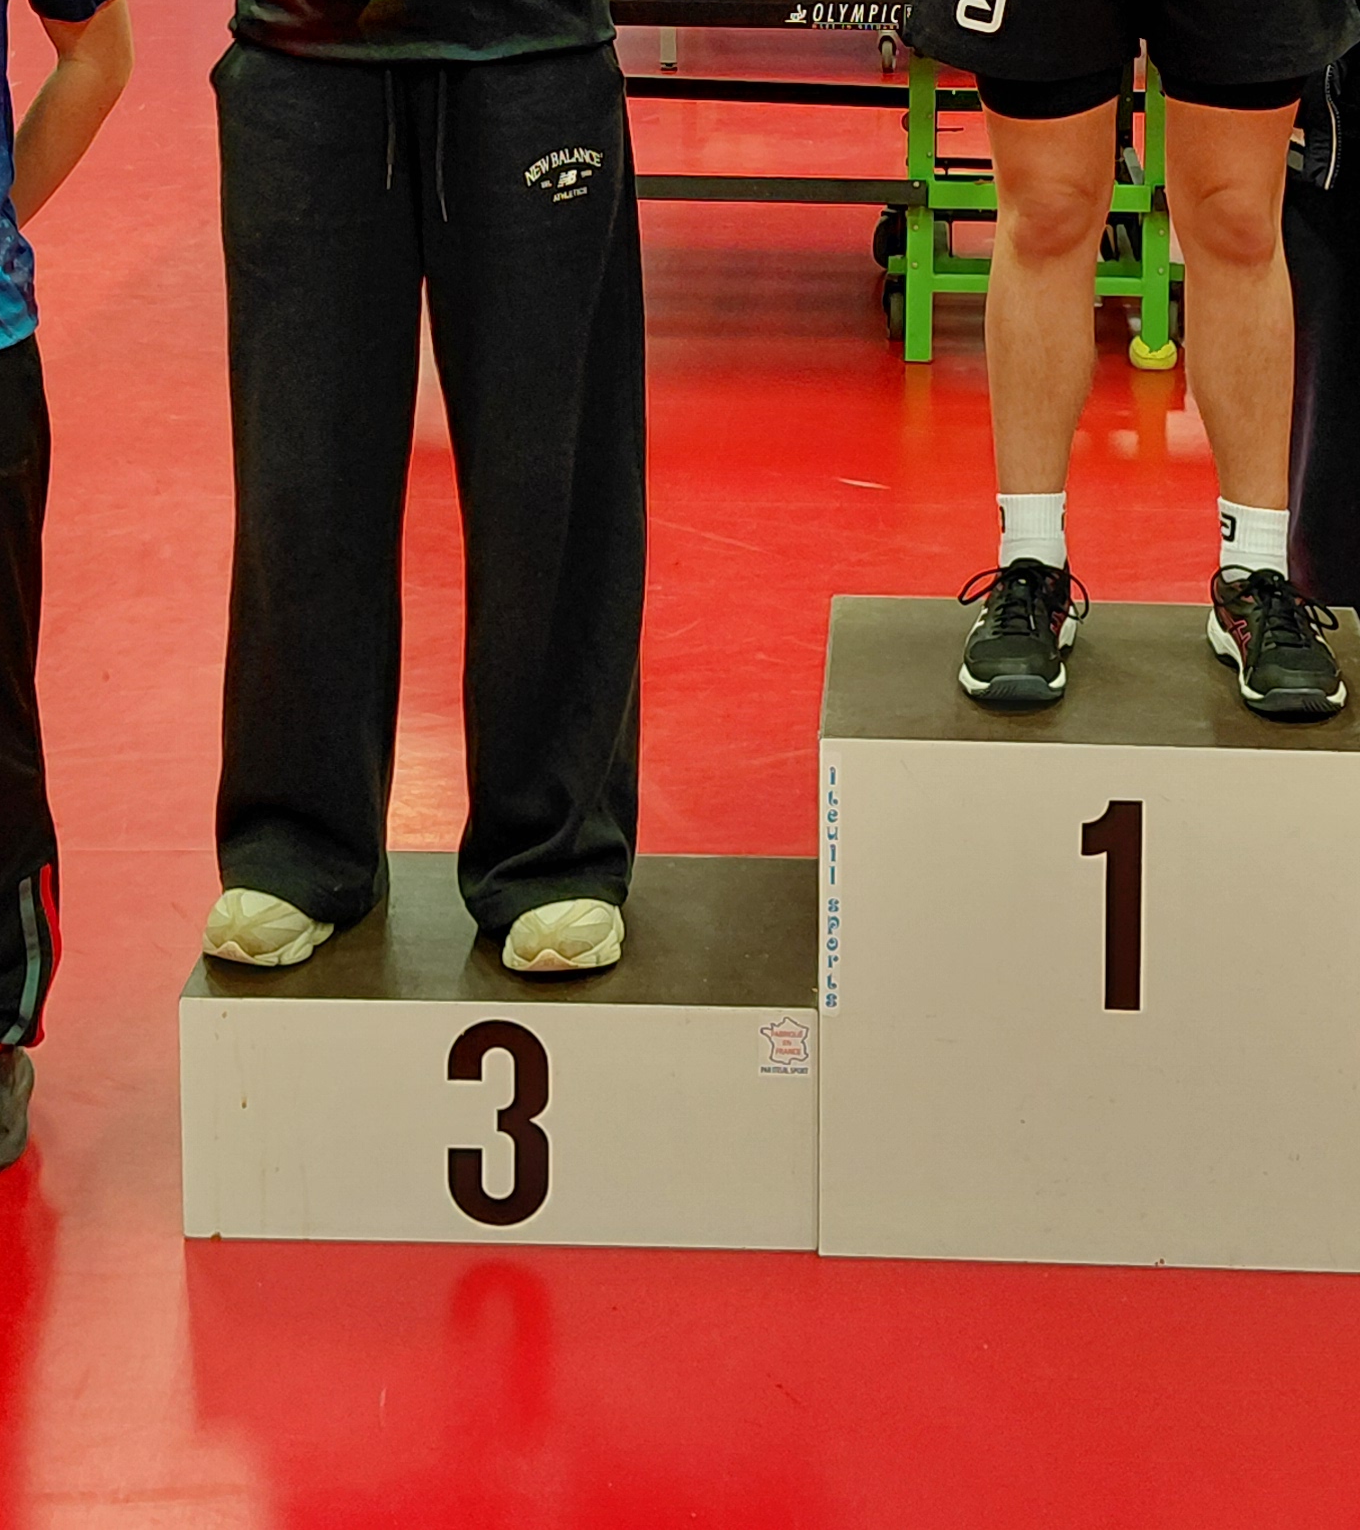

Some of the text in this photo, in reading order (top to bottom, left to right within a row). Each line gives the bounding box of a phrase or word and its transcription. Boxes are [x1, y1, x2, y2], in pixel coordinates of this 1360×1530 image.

[812, 3, 902, 24] OLYMPIC
[524, 147, 603, 188] NEW BALANCE
[1080, 799, 1144, 1012] 1
[446, 1018, 552, 1227] 3
